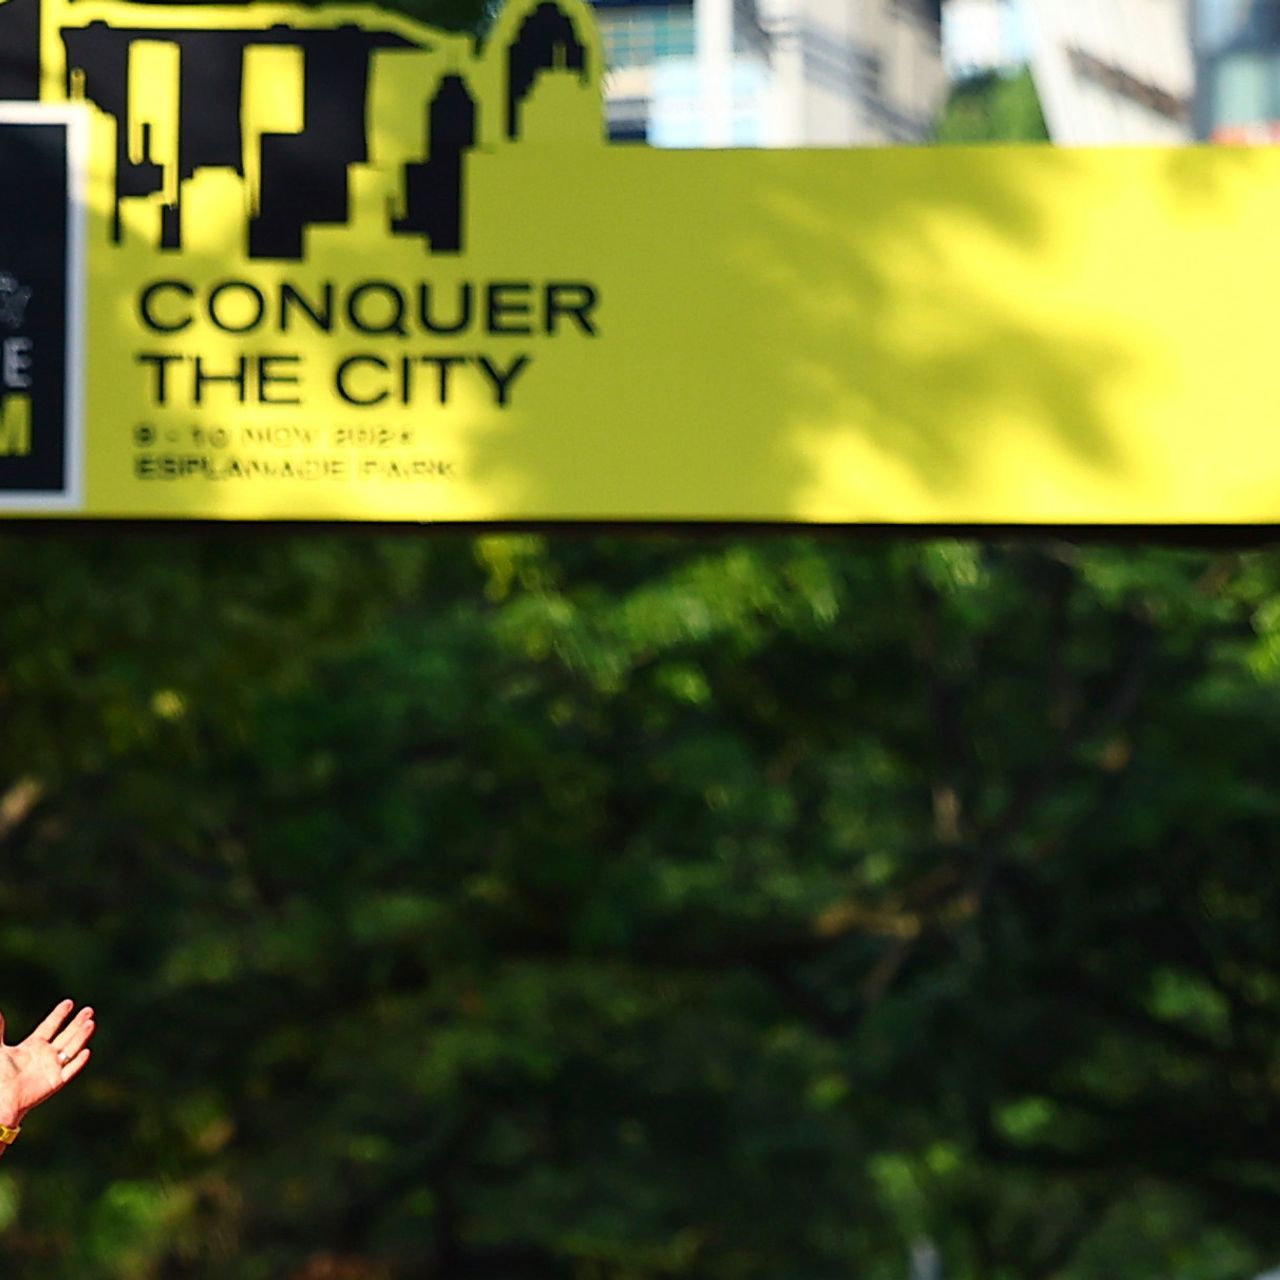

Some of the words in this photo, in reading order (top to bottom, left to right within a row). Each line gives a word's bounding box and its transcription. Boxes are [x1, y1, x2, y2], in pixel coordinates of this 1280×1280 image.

[139, 280, 599, 337] CONQUER
[136, 353, 301, 407] THE
[335, 353, 532, 407] CITY
